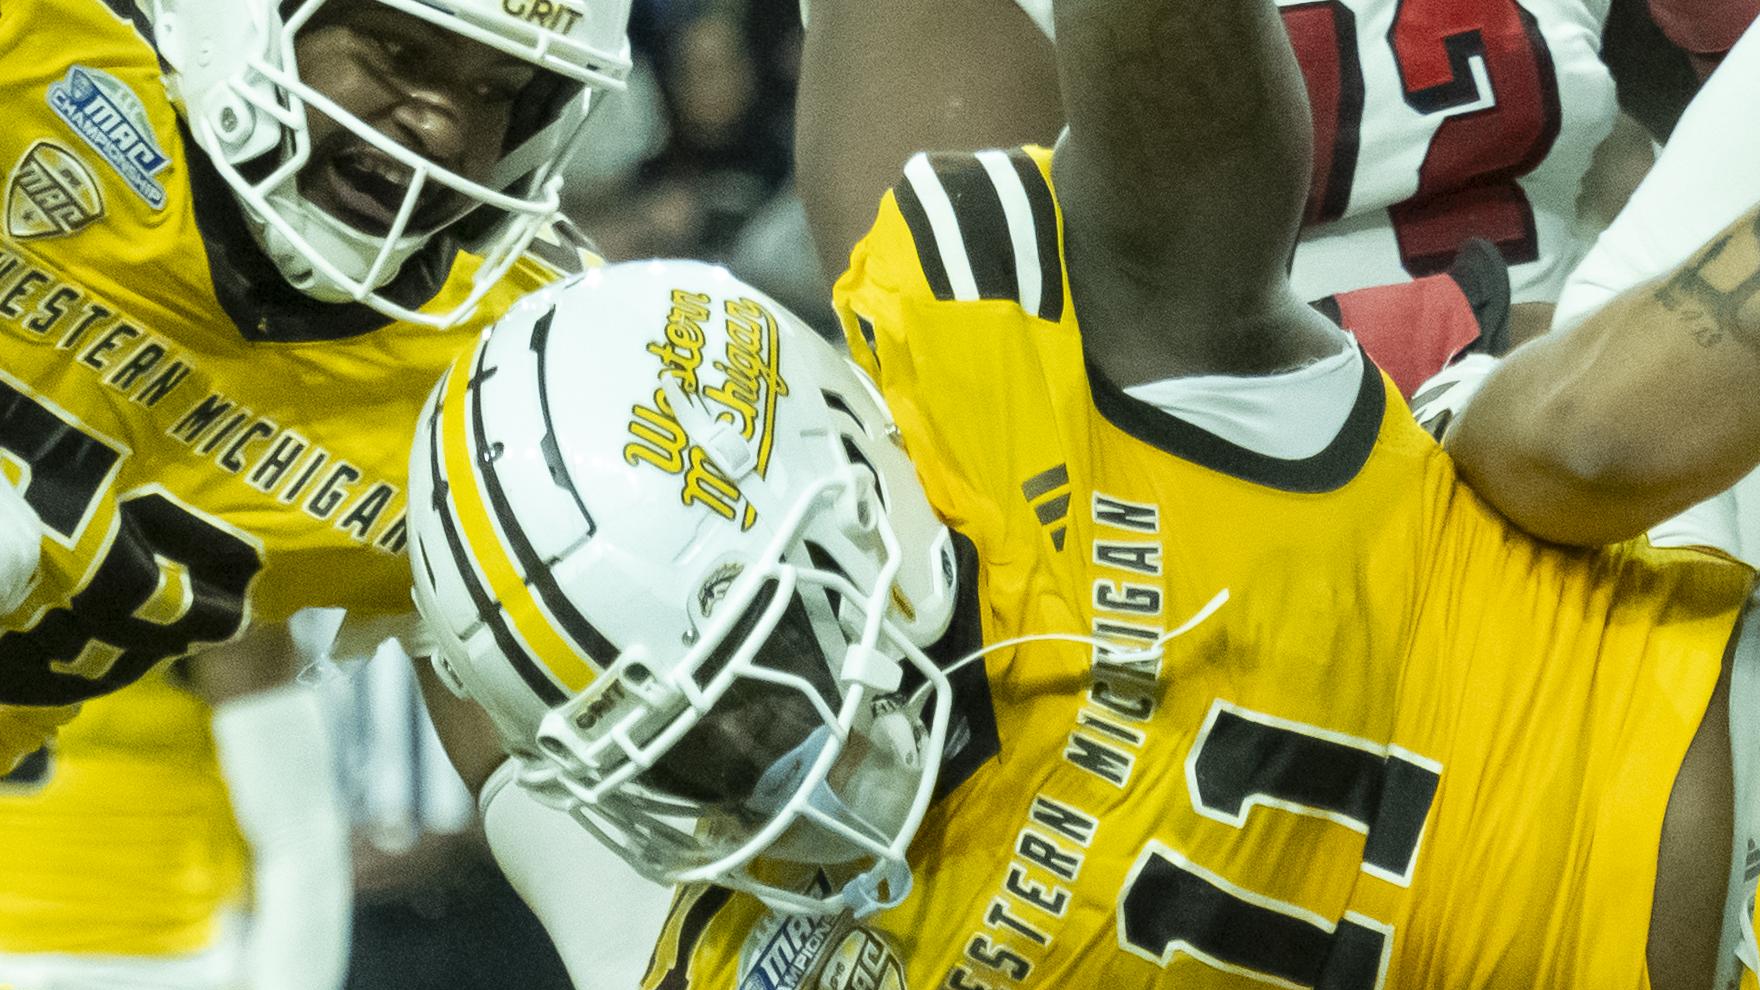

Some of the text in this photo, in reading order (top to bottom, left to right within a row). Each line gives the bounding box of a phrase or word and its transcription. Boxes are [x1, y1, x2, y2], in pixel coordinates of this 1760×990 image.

[17, 158, 86, 233] MAC
[0, 250, 195, 409] ESTERN
[760, 911, 824, 984] MA
